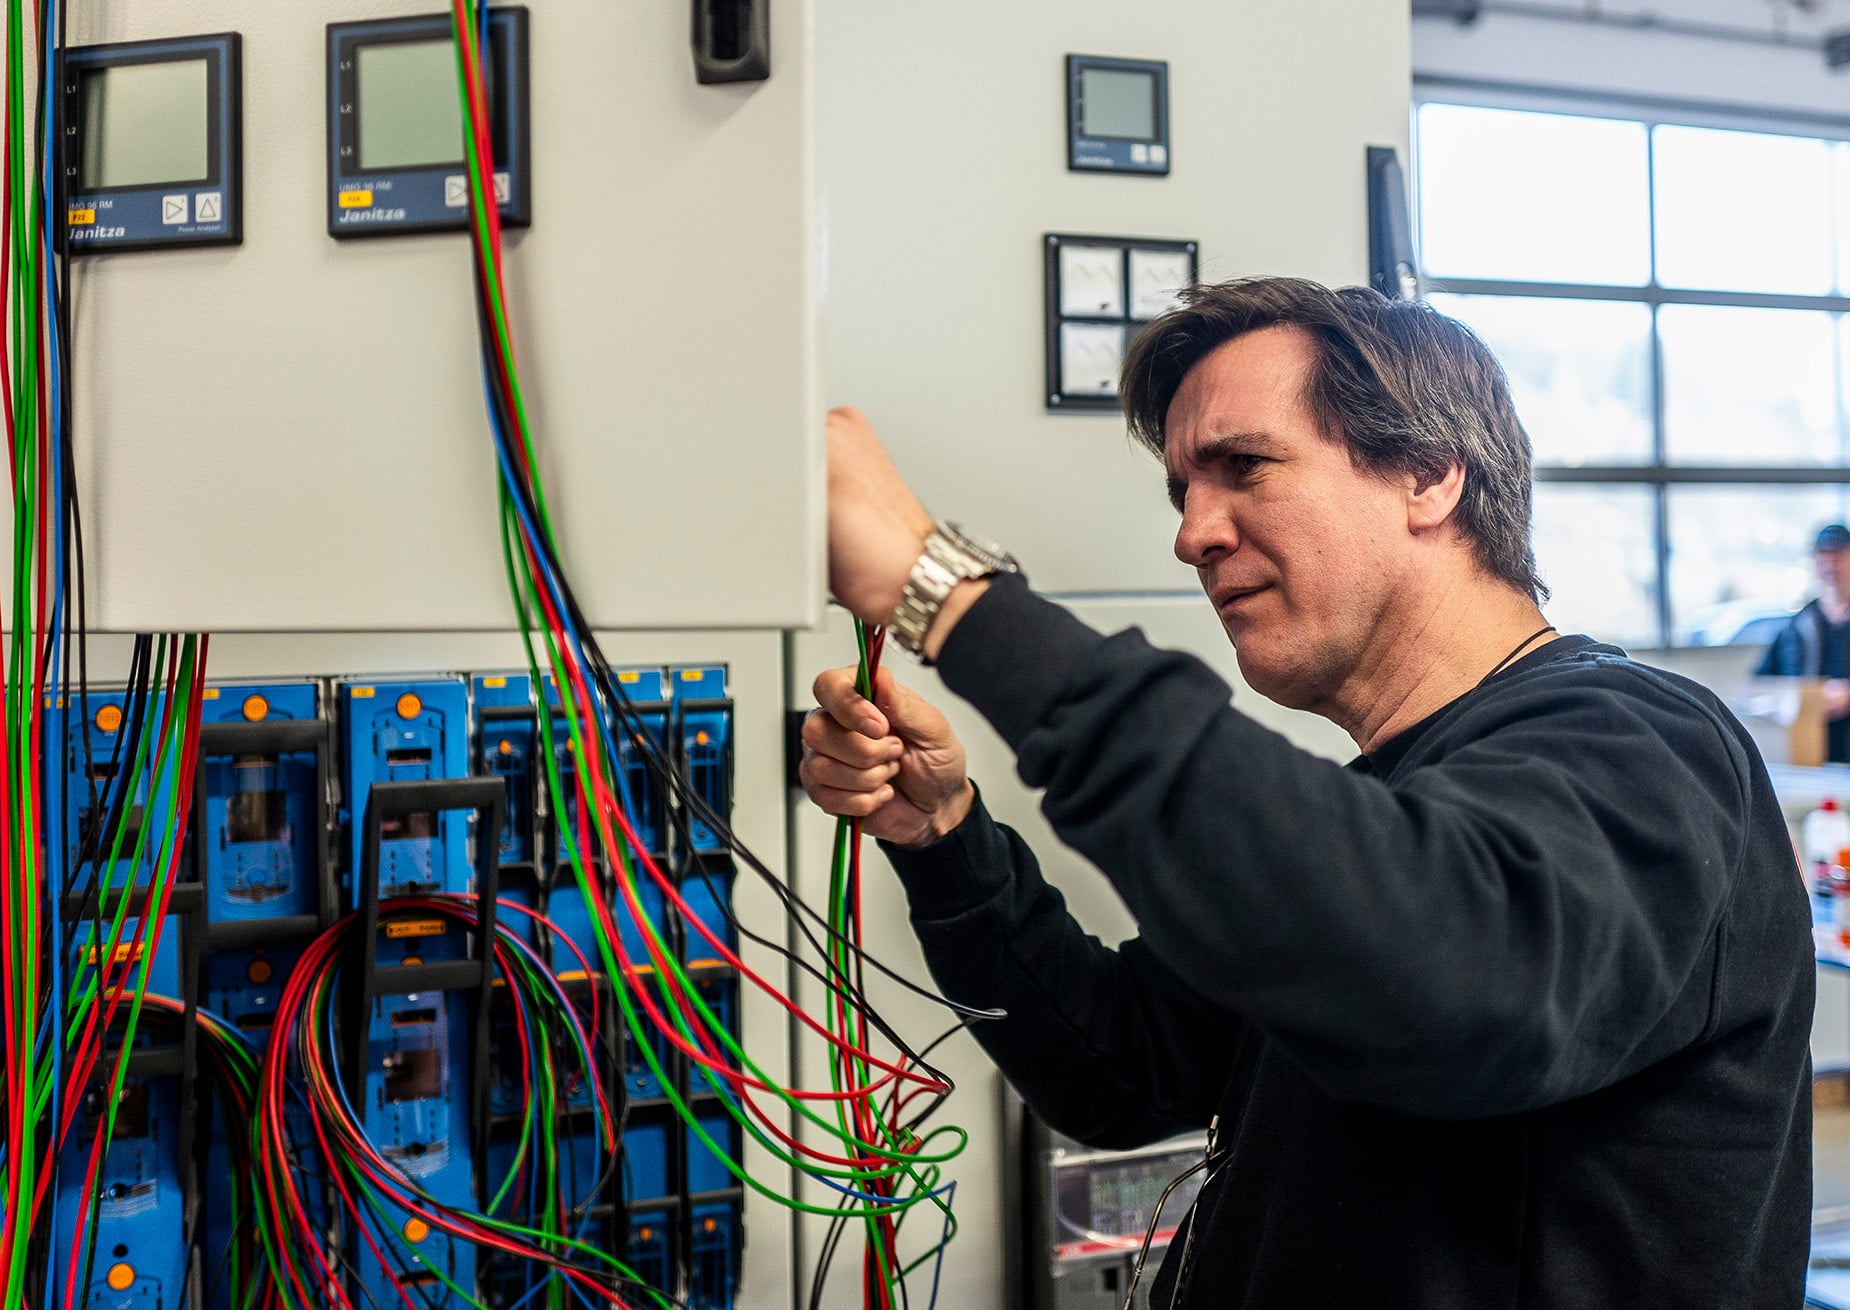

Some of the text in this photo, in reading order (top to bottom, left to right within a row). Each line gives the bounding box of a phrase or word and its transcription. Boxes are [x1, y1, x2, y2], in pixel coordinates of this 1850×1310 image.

[66, 85, 76, 94] L1
[66, 127, 76, 135] L2
[66, 167, 76, 176] L3
[99, 200, 113, 209] RM
[339, 207, 406, 223] Janitza
